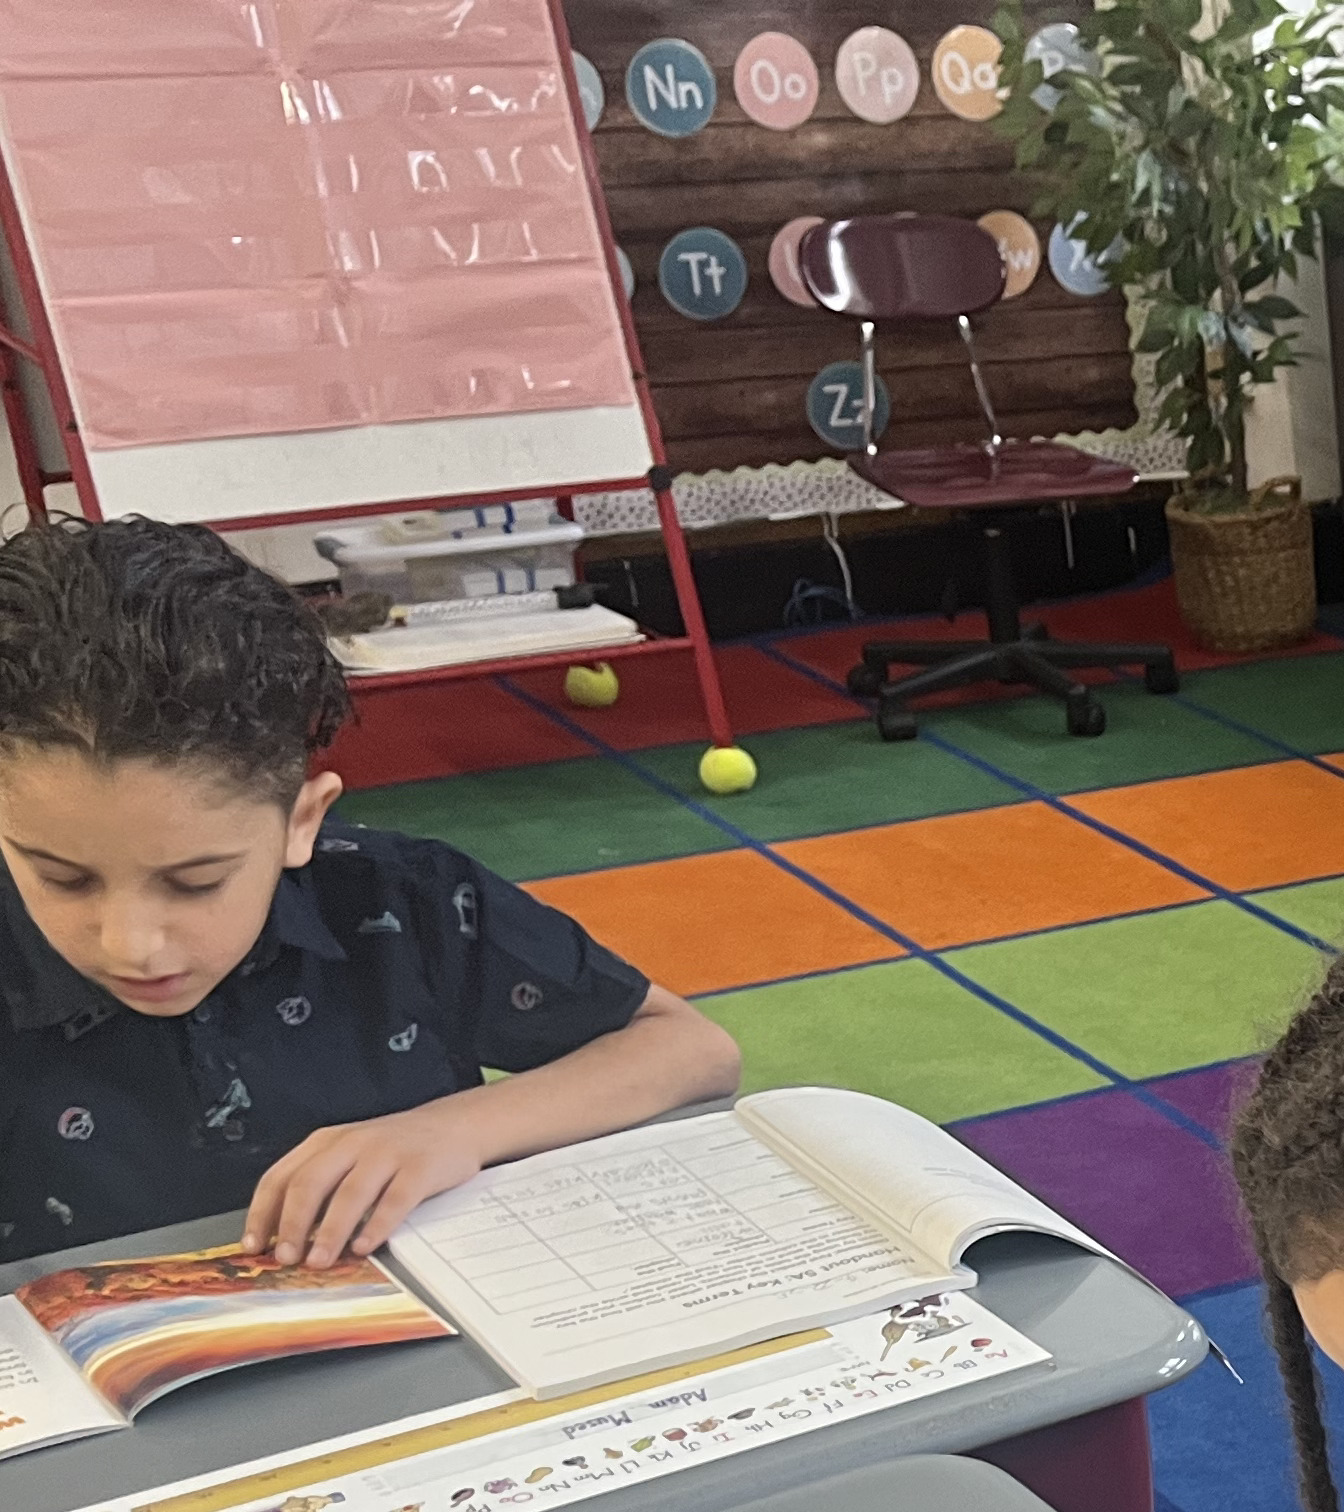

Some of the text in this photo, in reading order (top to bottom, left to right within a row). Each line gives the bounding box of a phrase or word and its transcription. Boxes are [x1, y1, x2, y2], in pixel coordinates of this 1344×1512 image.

[644, 52, 903, 112] Nn Oo Pp
[677, 252, 726, 296] Tt
